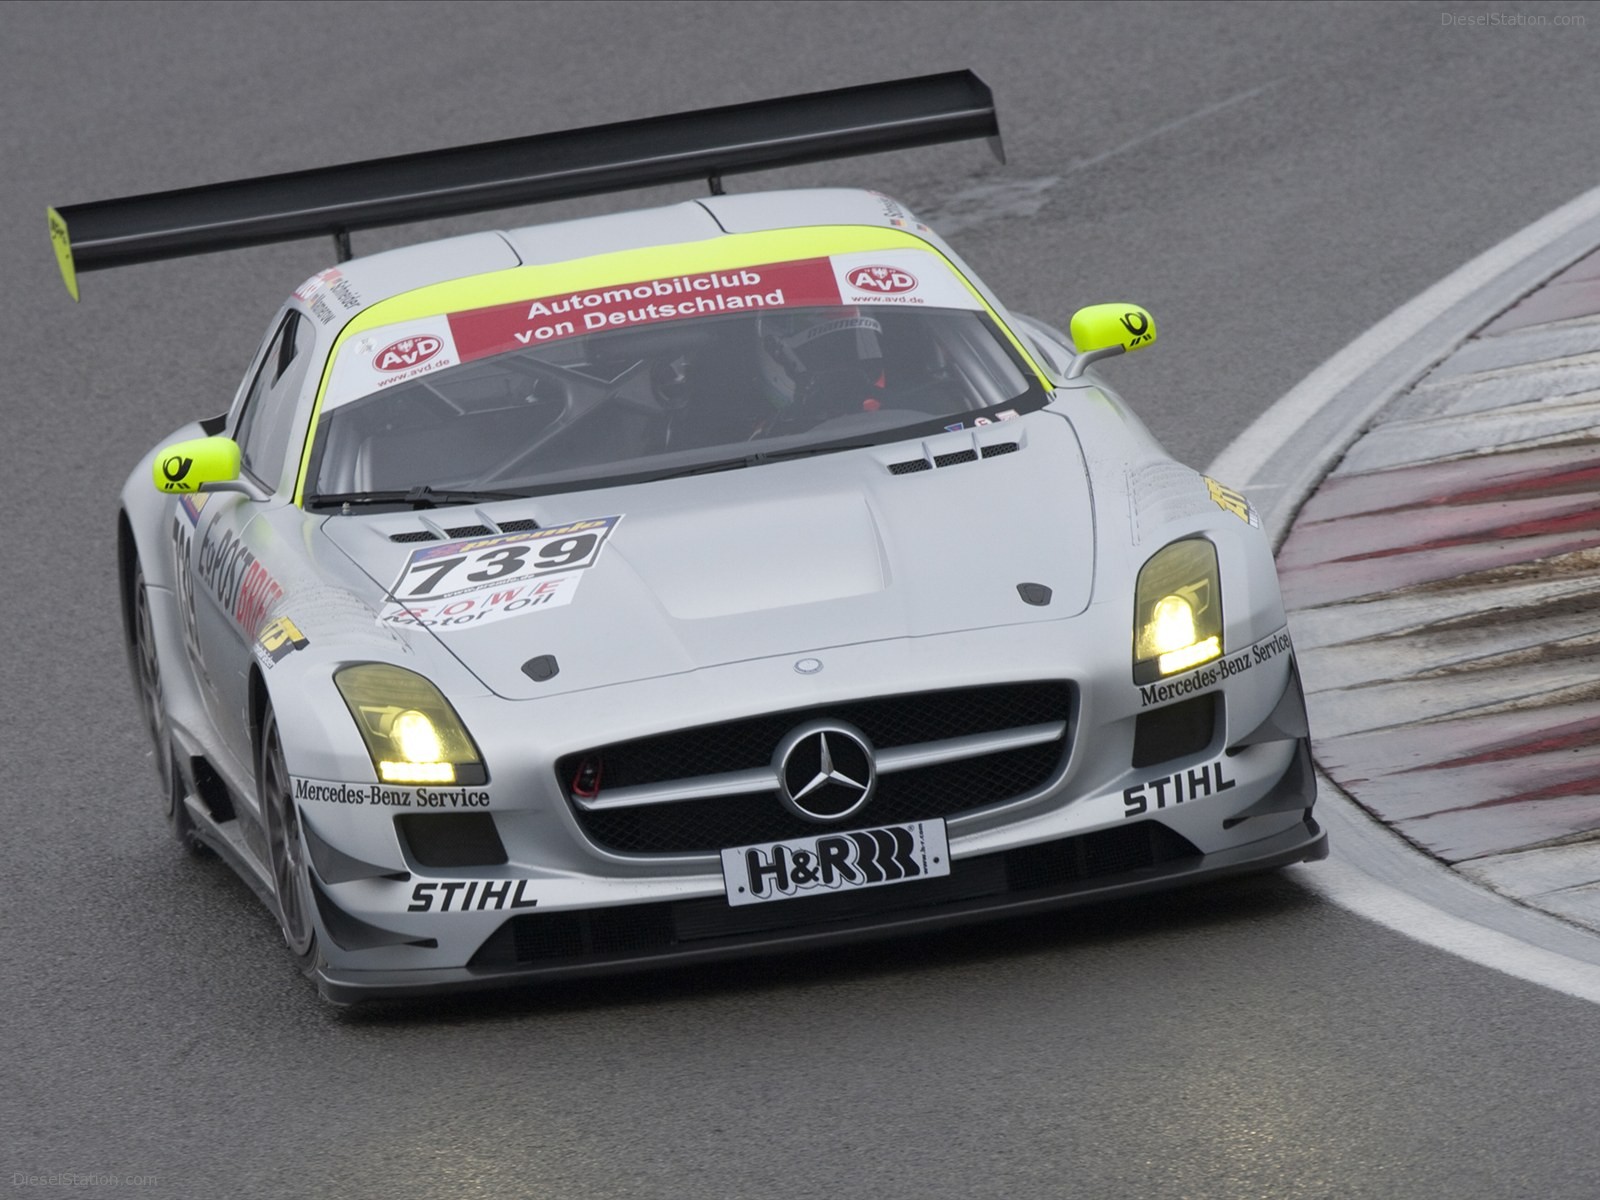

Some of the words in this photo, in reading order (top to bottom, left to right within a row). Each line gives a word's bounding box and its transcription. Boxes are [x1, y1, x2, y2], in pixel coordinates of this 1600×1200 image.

[527, 270, 761, 320] Automobilclub
[855, 272, 914, 291] AvD
[514, 321, 575, 344] von
[583, 289, 785, 330] Deutschland
[851, 296, 924, 304] www.avd.de
[381, 338, 440, 369] AvD
[377, 358, 450, 387] www.avd.de
[408, 533, 598, 596] 739
[383, 609, 493, 627] Motor
[503, 592, 554, 612] Oil
[1139, 653, 1252, 707] Mercedes-Benz
[1252, 632, 1291, 665] Service
[295, 779, 411, 806] Mercedes-Benz
[416, 788, 490, 808] Service
[1123, 762, 1236, 817] STIHL
[407, 879, 538, 912] STIHL
